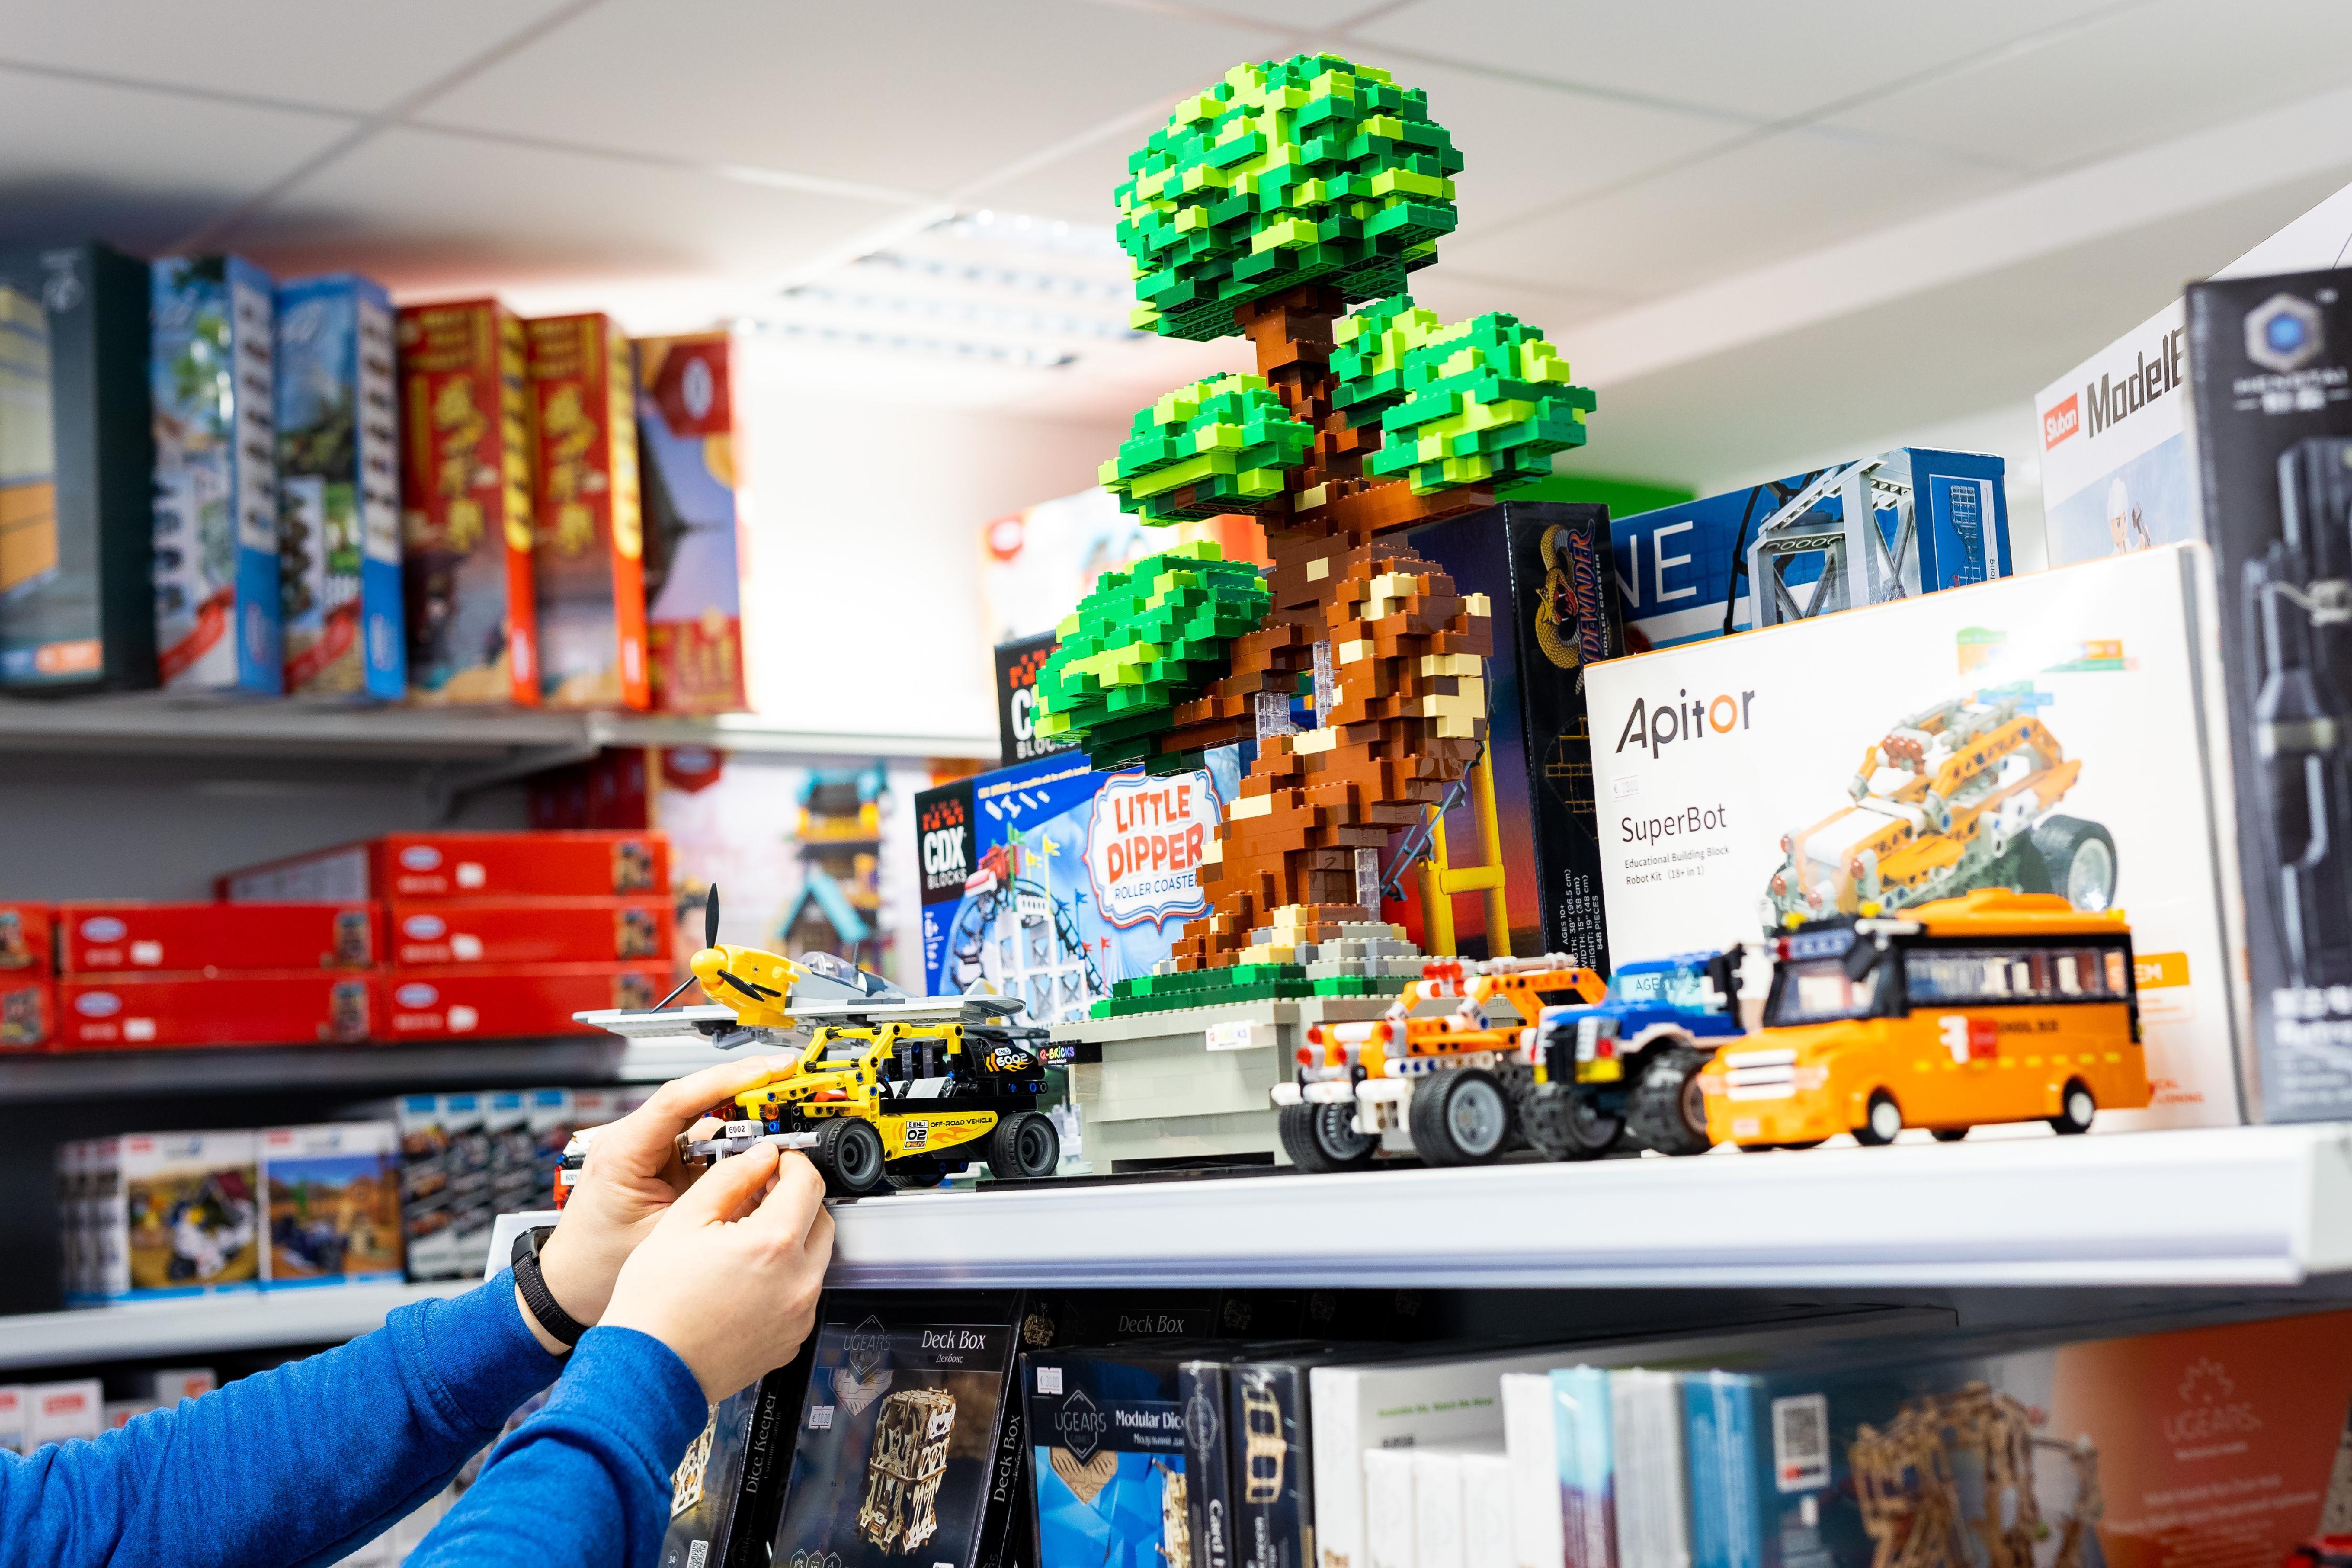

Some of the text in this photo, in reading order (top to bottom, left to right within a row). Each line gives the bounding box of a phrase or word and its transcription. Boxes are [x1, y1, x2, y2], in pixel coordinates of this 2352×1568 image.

[2045, 409, 2077, 442] Sluban
[1595, 554, 1604, 608] COASTER
[1615, 688, 1755, 759] Apitor
[1016, 738, 1076, 759] BLOC
[1114, 785, 1191, 834] LITTLE
[1622, 803, 1727, 846] SuperBot
[923, 825, 967, 875] CDX
[1107, 822, 1204, 885] DIPPER
[1625, 845, 1729, 869] Educational Building Block
[927, 868, 967, 890] BLOCKS
[1626, 875, 1649, 885] Robot
[1651, 871, 1662, 881] Kit
[1687, 867, 1695, 876] in
[1115, 882, 1151, 900] ROLLER
[1566, 890, 1575, 914] (96.5
[1592, 896, 1601, 929] PIECES
[1579, 933, 1588, 969] WIDTH:
[1588, 932, 1597, 971] HEIGHT:
[996, 1053, 1028, 1067] 6002
[729, 1125, 746, 1134] 6002
[908, 1130, 927, 1140] 02
[930, 1119, 965, 1128] OFF-ROAD
[1119, 1315, 1184, 1333] Deck Box
[844, 1334, 891, 1351] UGEARS
[921, 1330, 986, 1349] Deck Box
[936, 1354, 963, 1363] Декбокс
[754, 1392, 776, 1452] Keeper
[1055, 1411, 1107, 1433] UGEARS
[1116, 1410, 1184, 1430] Modular Dic
[994, 1415, 1020, 1502] Deck Box
[746, 1457, 763, 1493] Dice
